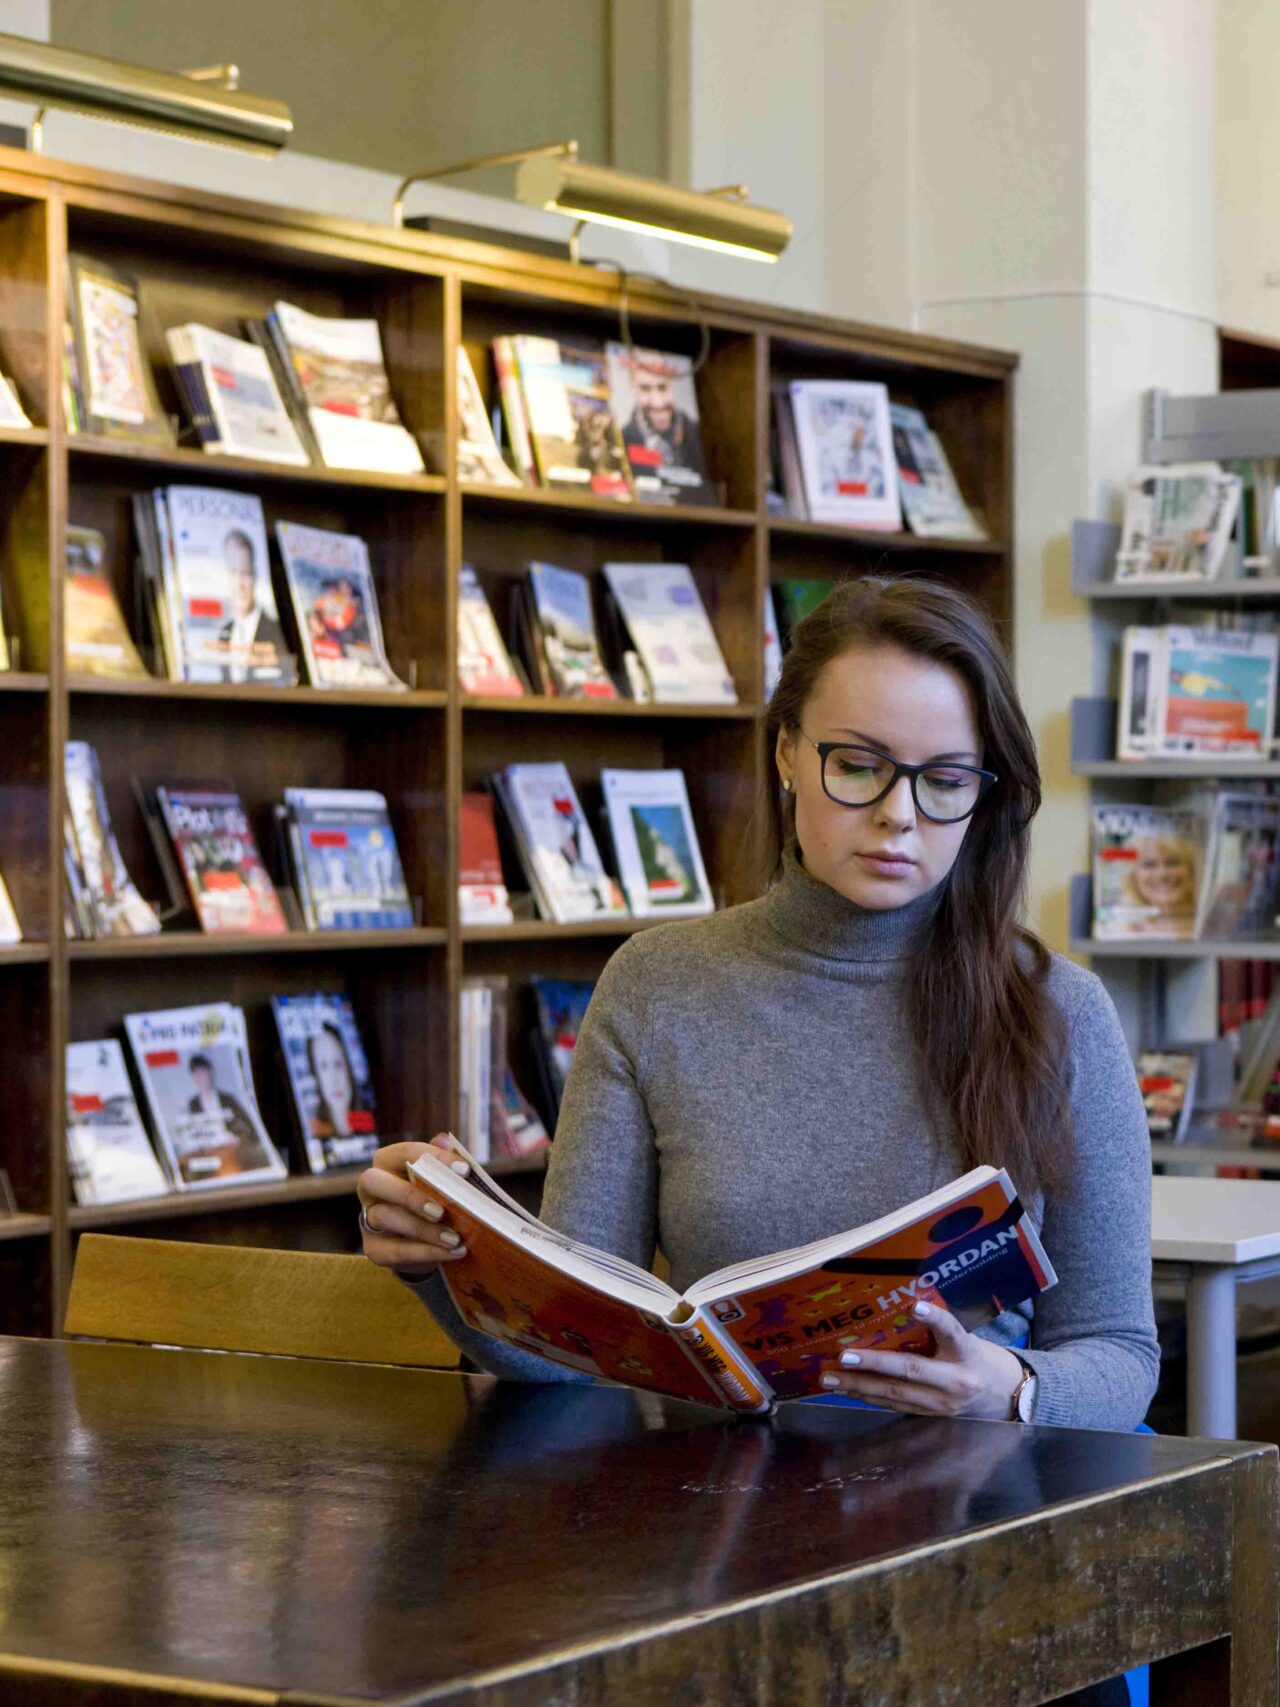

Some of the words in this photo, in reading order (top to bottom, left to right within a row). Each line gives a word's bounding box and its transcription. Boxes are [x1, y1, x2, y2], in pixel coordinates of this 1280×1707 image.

[742, 1330, 795, 1352] VIS
[801, 1303, 874, 1339] MEG
[876, 1225, 1020, 1310] HVORDAN
